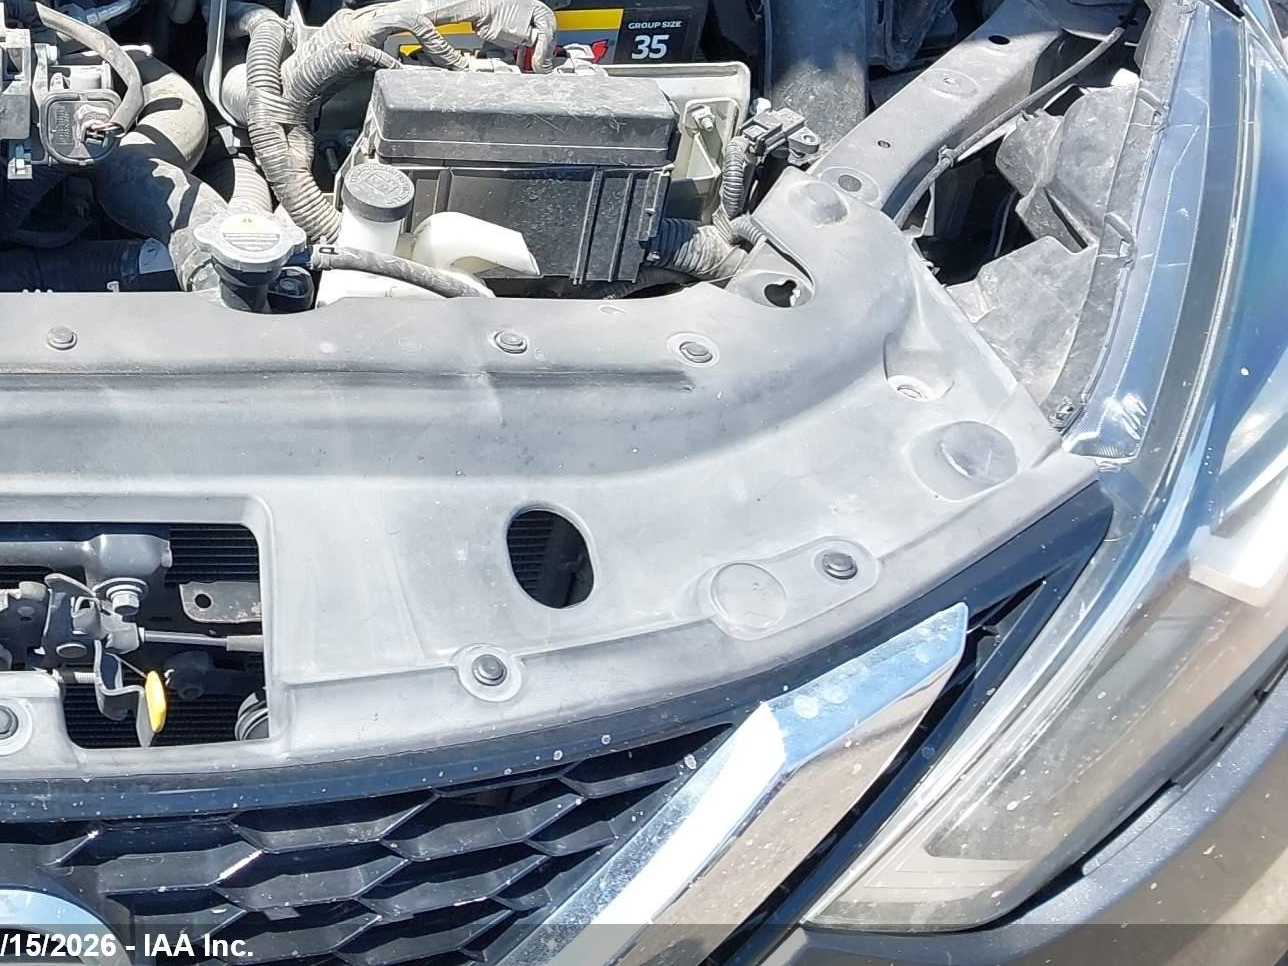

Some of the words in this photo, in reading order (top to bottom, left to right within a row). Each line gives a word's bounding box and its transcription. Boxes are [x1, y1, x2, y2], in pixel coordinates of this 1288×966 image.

[628, 21, 661, 30] GROUP
[661, 20, 682, 28] SIZE
[631, 34, 670, 60] 35
